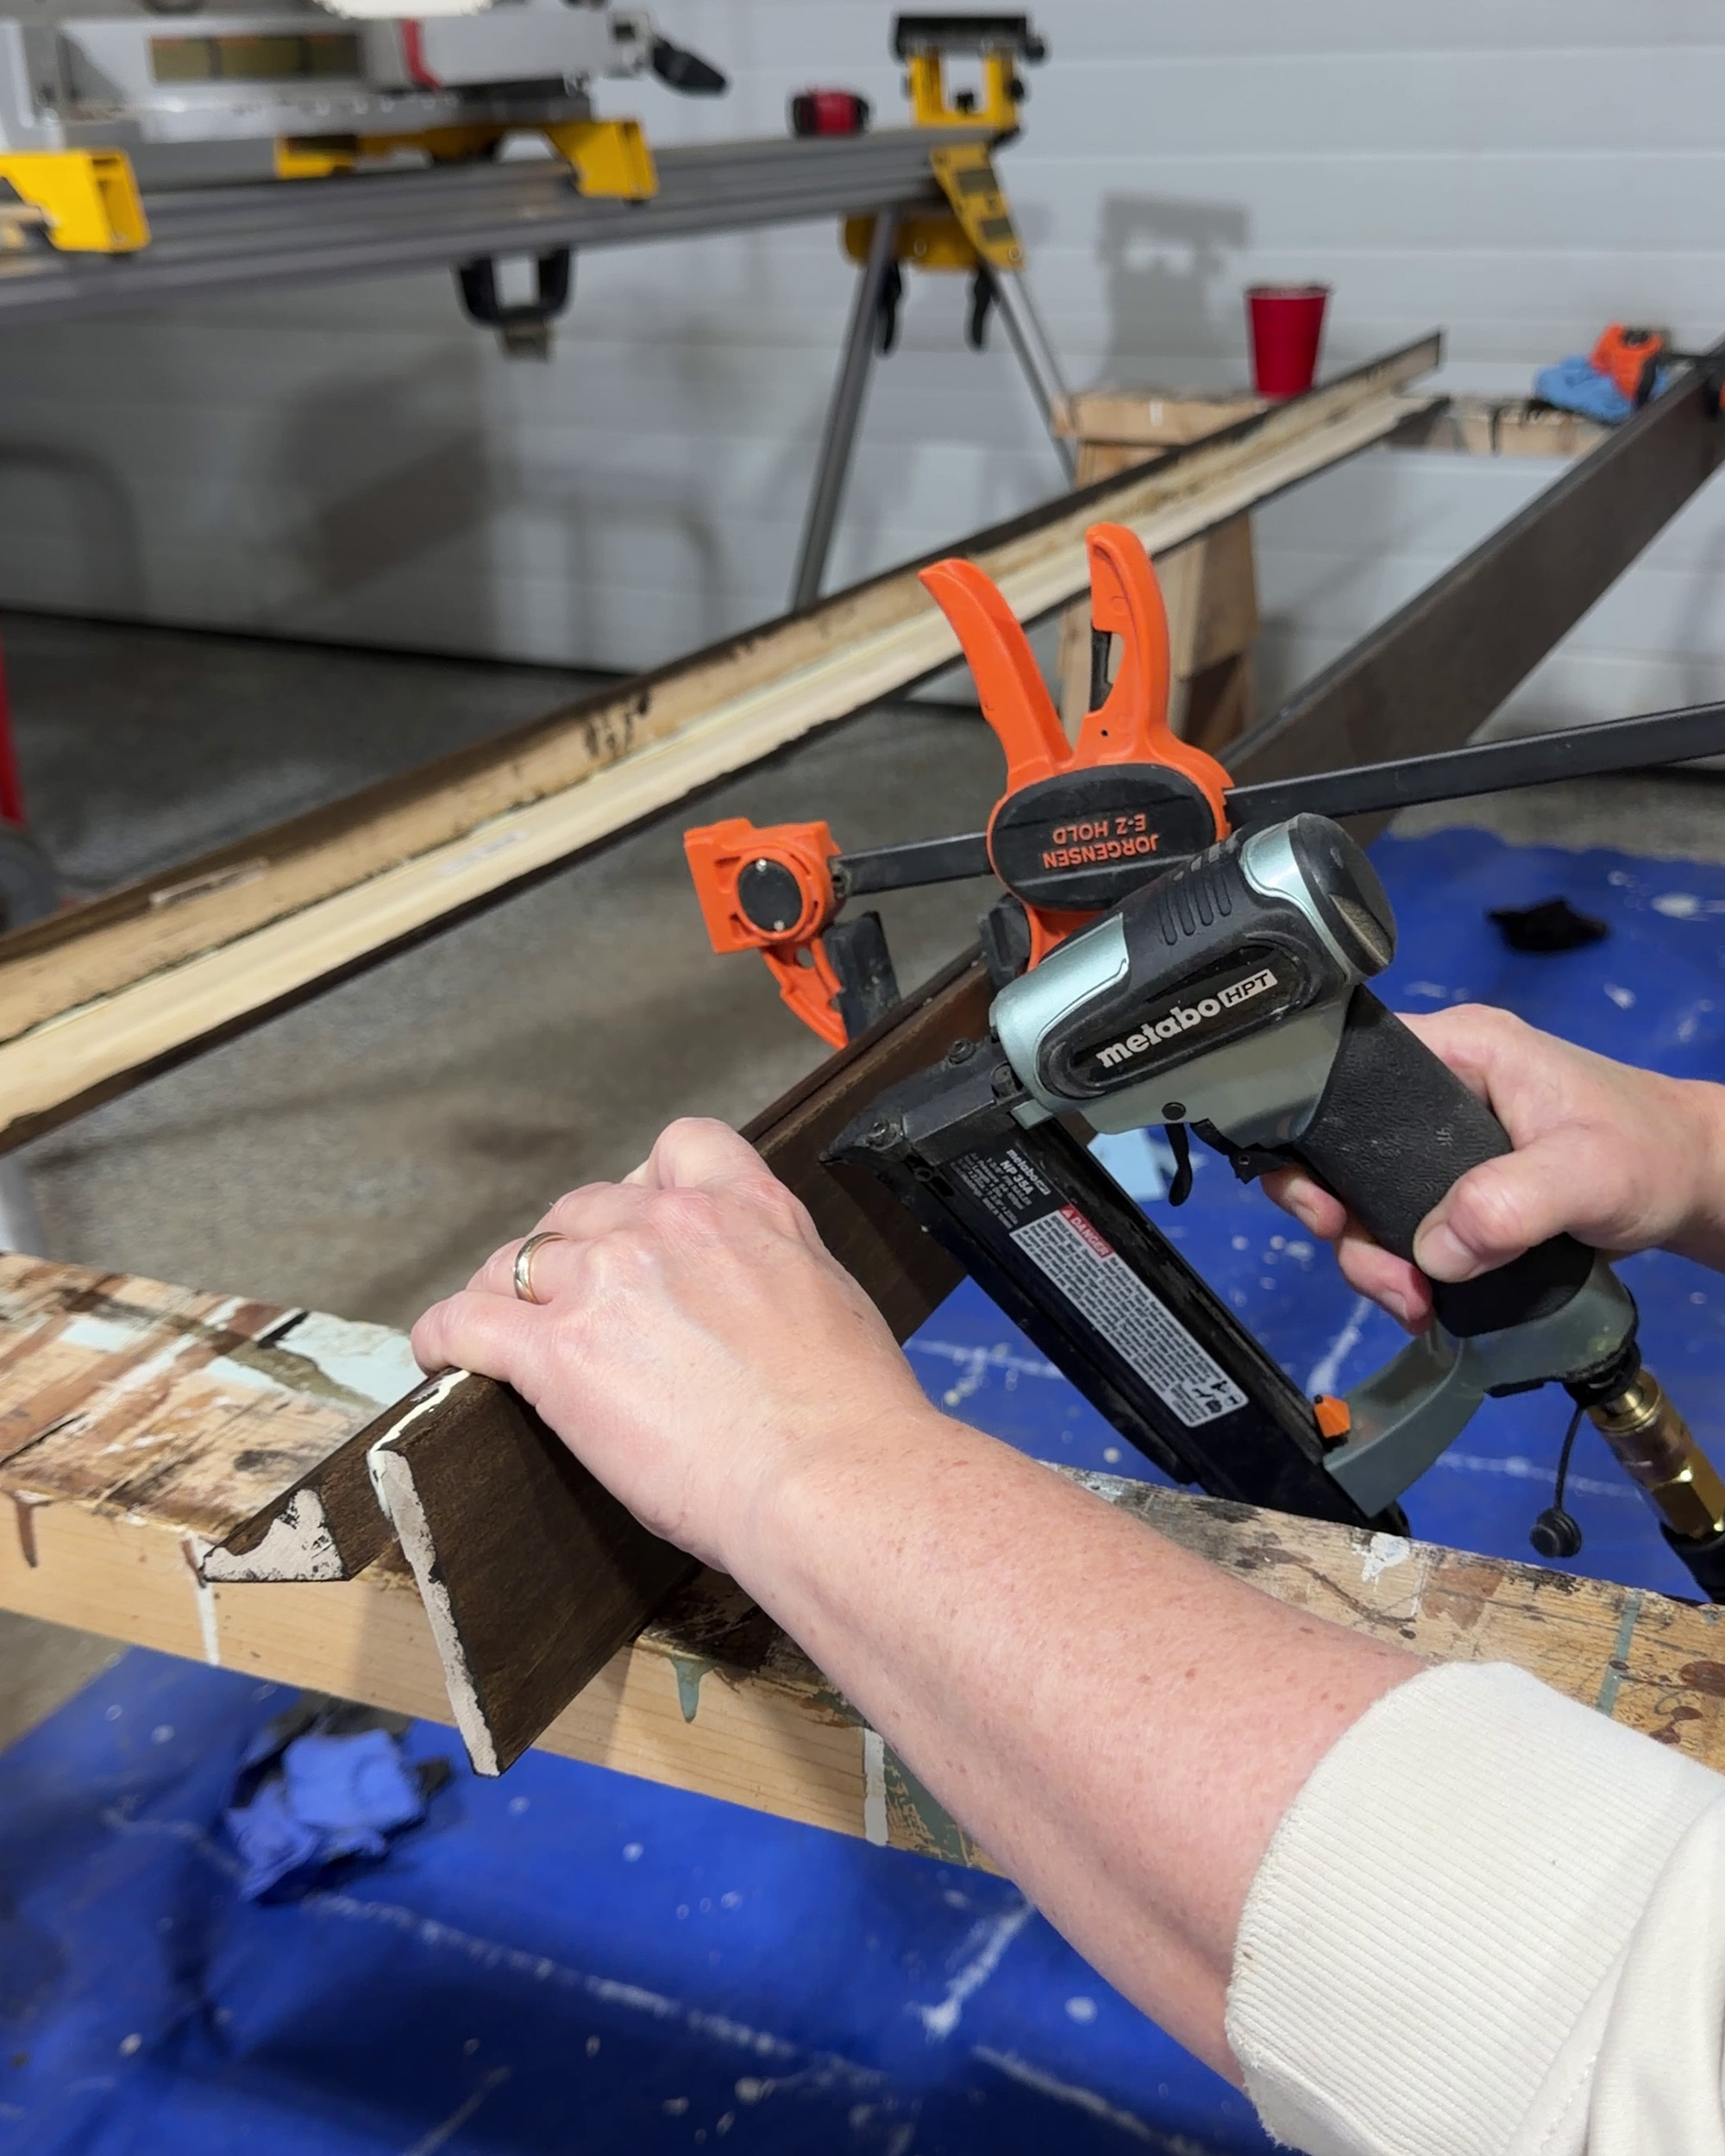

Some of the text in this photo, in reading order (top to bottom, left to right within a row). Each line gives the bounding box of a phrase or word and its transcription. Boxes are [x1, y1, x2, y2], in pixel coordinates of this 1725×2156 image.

[1052, 820, 1109, 845] HOLD
[1042, 833, 1159, 869] JORGENSEN
[1095, 972, 1268, 1069] metabo HPT
[1000, 1160, 1018, 1175] NP
[1070, 1216, 1109, 1257] DANGER
